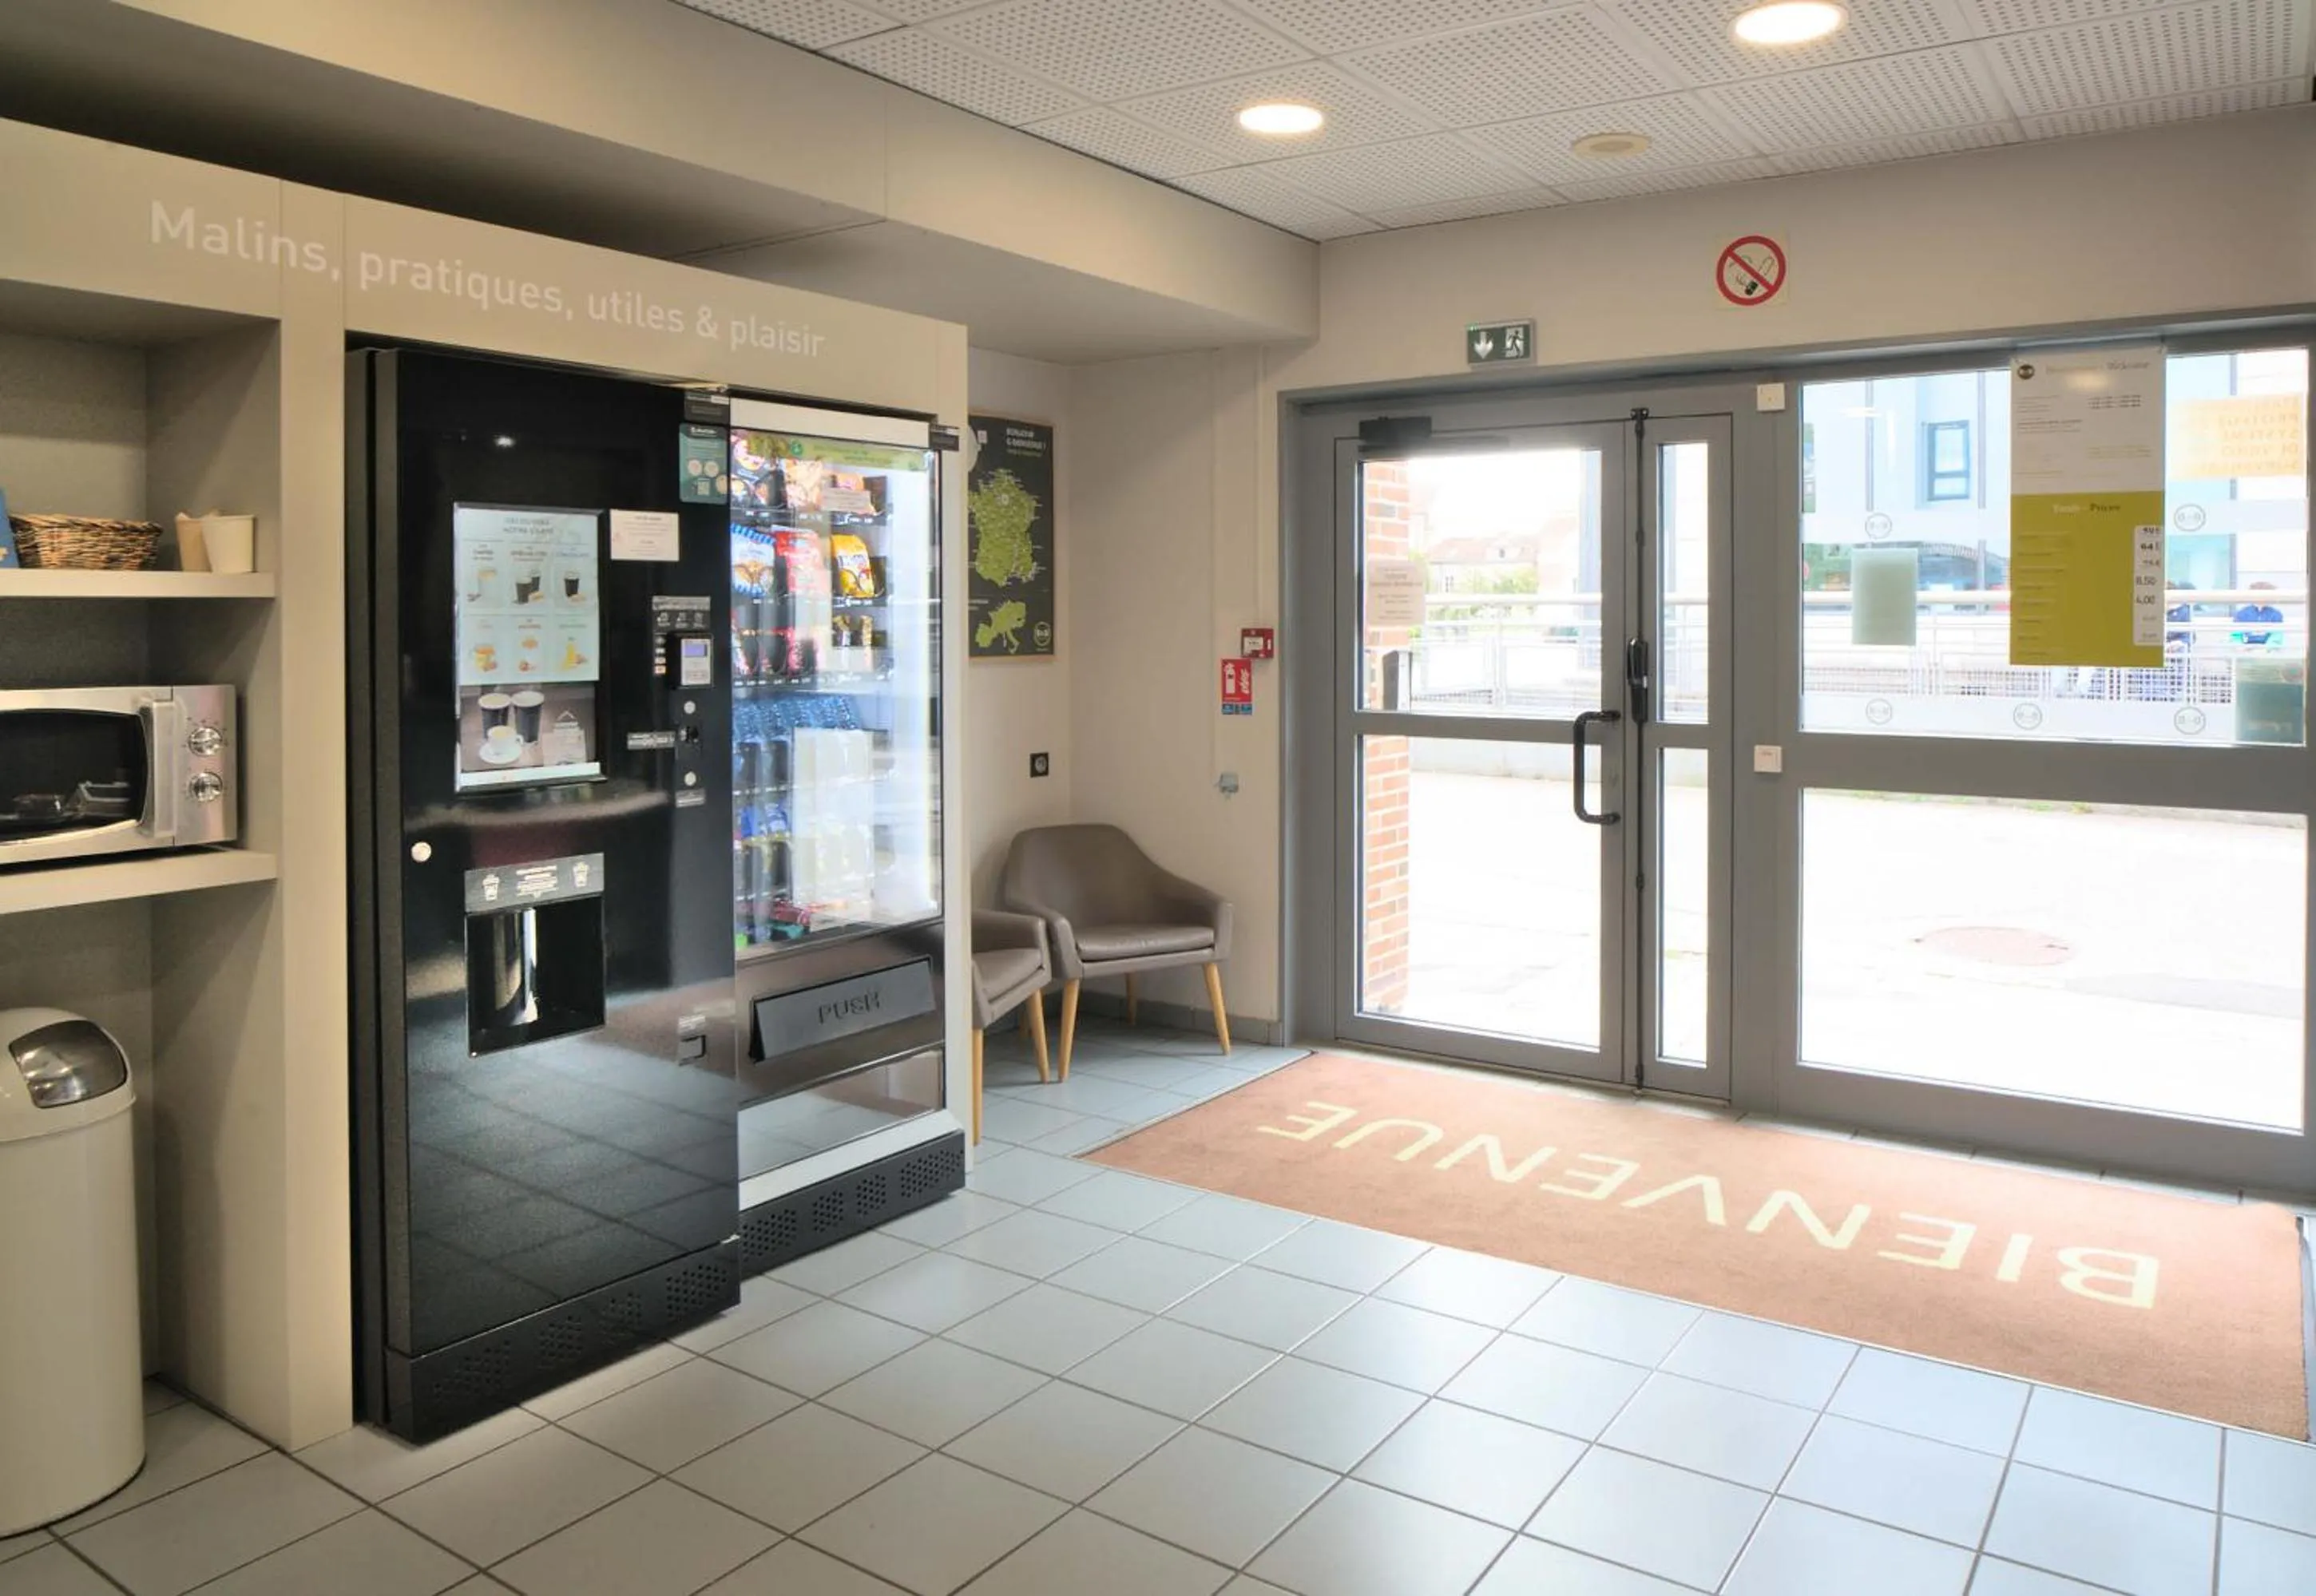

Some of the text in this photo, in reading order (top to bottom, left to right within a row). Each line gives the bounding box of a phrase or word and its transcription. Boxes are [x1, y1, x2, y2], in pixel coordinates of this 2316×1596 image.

[151, 200, 827, 359] Malins, pratiques, utiles & plaisir
[817, 990, 882, 1025] PUSH
[1257, 1099, 2162, 1311] BIENVENUE
